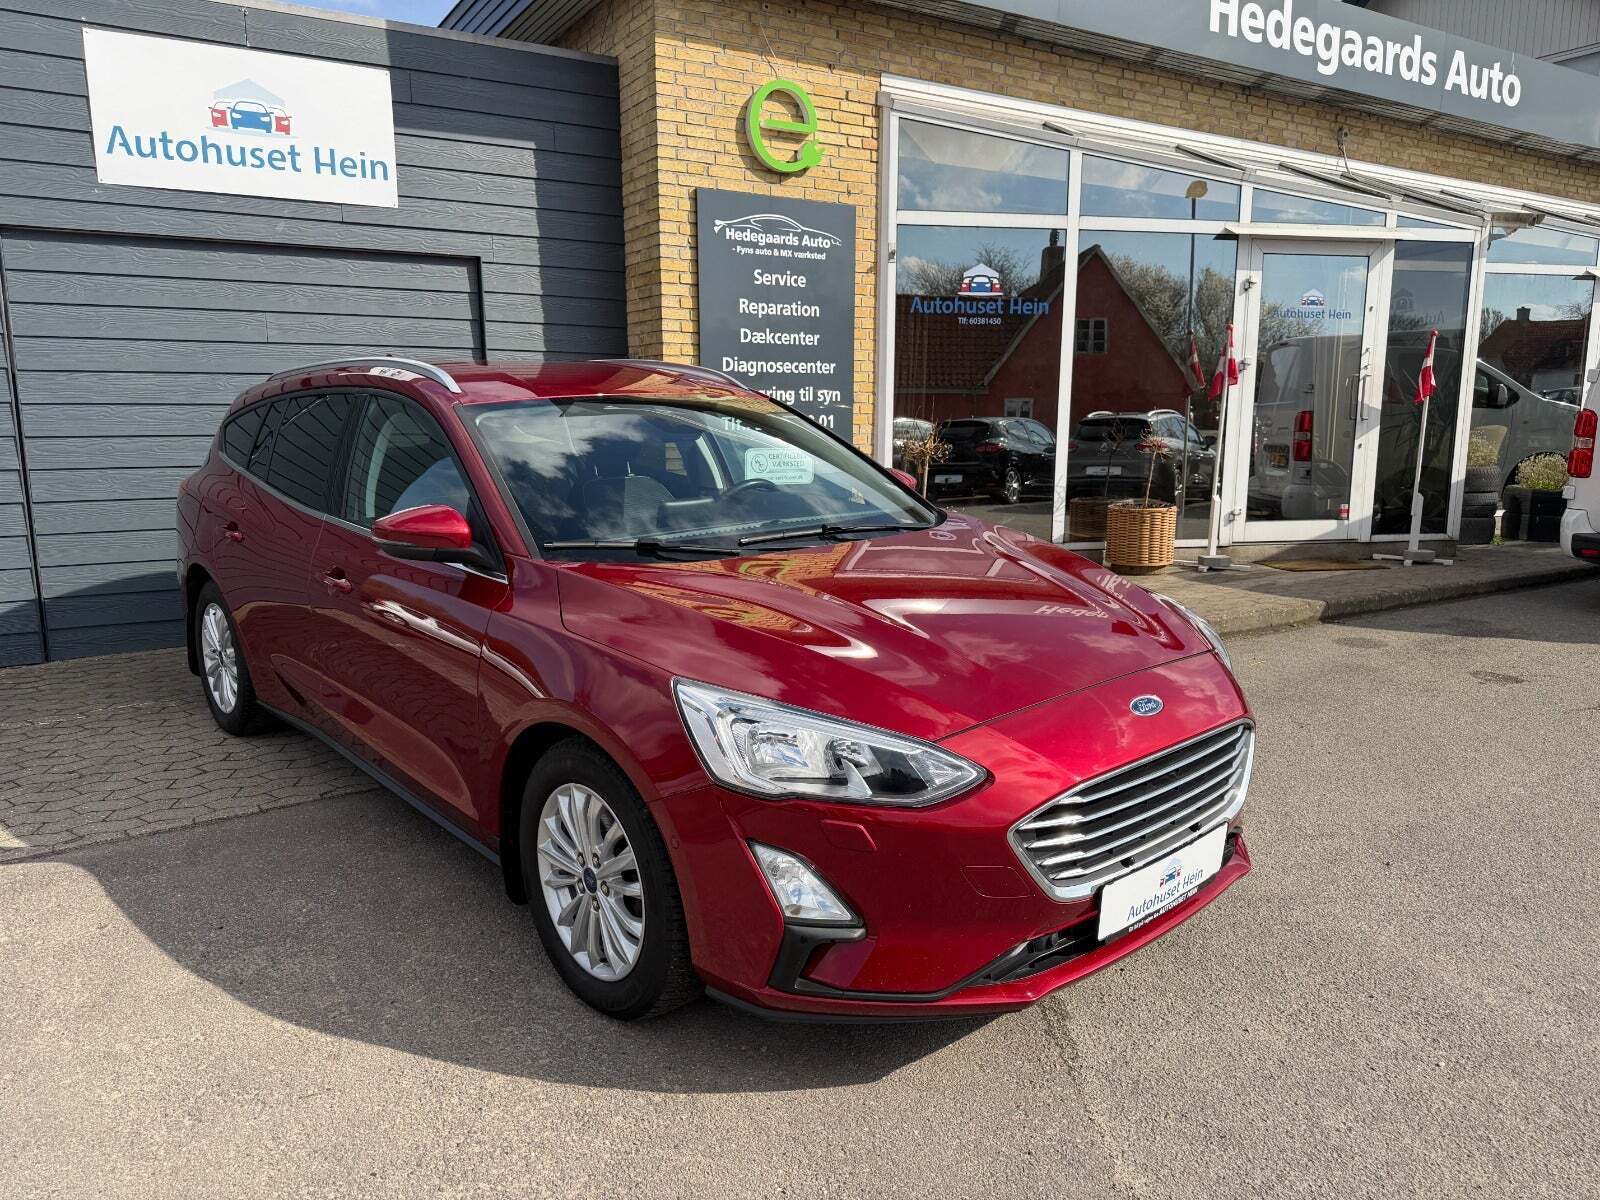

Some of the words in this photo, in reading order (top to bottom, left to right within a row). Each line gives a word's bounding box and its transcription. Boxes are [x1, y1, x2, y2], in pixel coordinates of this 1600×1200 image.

[1209, 0, 1437, 86] Hedegaards
[1445, 49, 1521, 107] Auto
[106, 125, 302, 173] Autohuset
[314, 146, 389, 181] Hein
[725, 227, 799, 246] Hedegaards
[801, 235, 831, 248] Auto
[736, 246, 754, 255] Fyns
[755, 248, 772, 256] auto
[773, 248, 779, 256] &
[780, 249, 792, 257] MX
[793, 251, 826, 260] værksted
[753, 269, 807, 288] Service
[739, 298, 820, 318] Reparation
[910, 296, 1005, 314] Autohuset
[1009, 297, 1049, 315] Hein
[1273, 307, 1325, 319] Autohuset
[1329, 309, 1351, 320] Hein
[740, 328, 820, 346] Dækcenter
[722, 356, 836, 376] Diagnosecenter
[799, 387, 813, 402] til
[817, 389, 841, 405] syn
[1136, 699, 1157, 712] Ford
[1127, 881, 1181, 920] Autohuset
[1183, 869, 1203, 888] Hein
